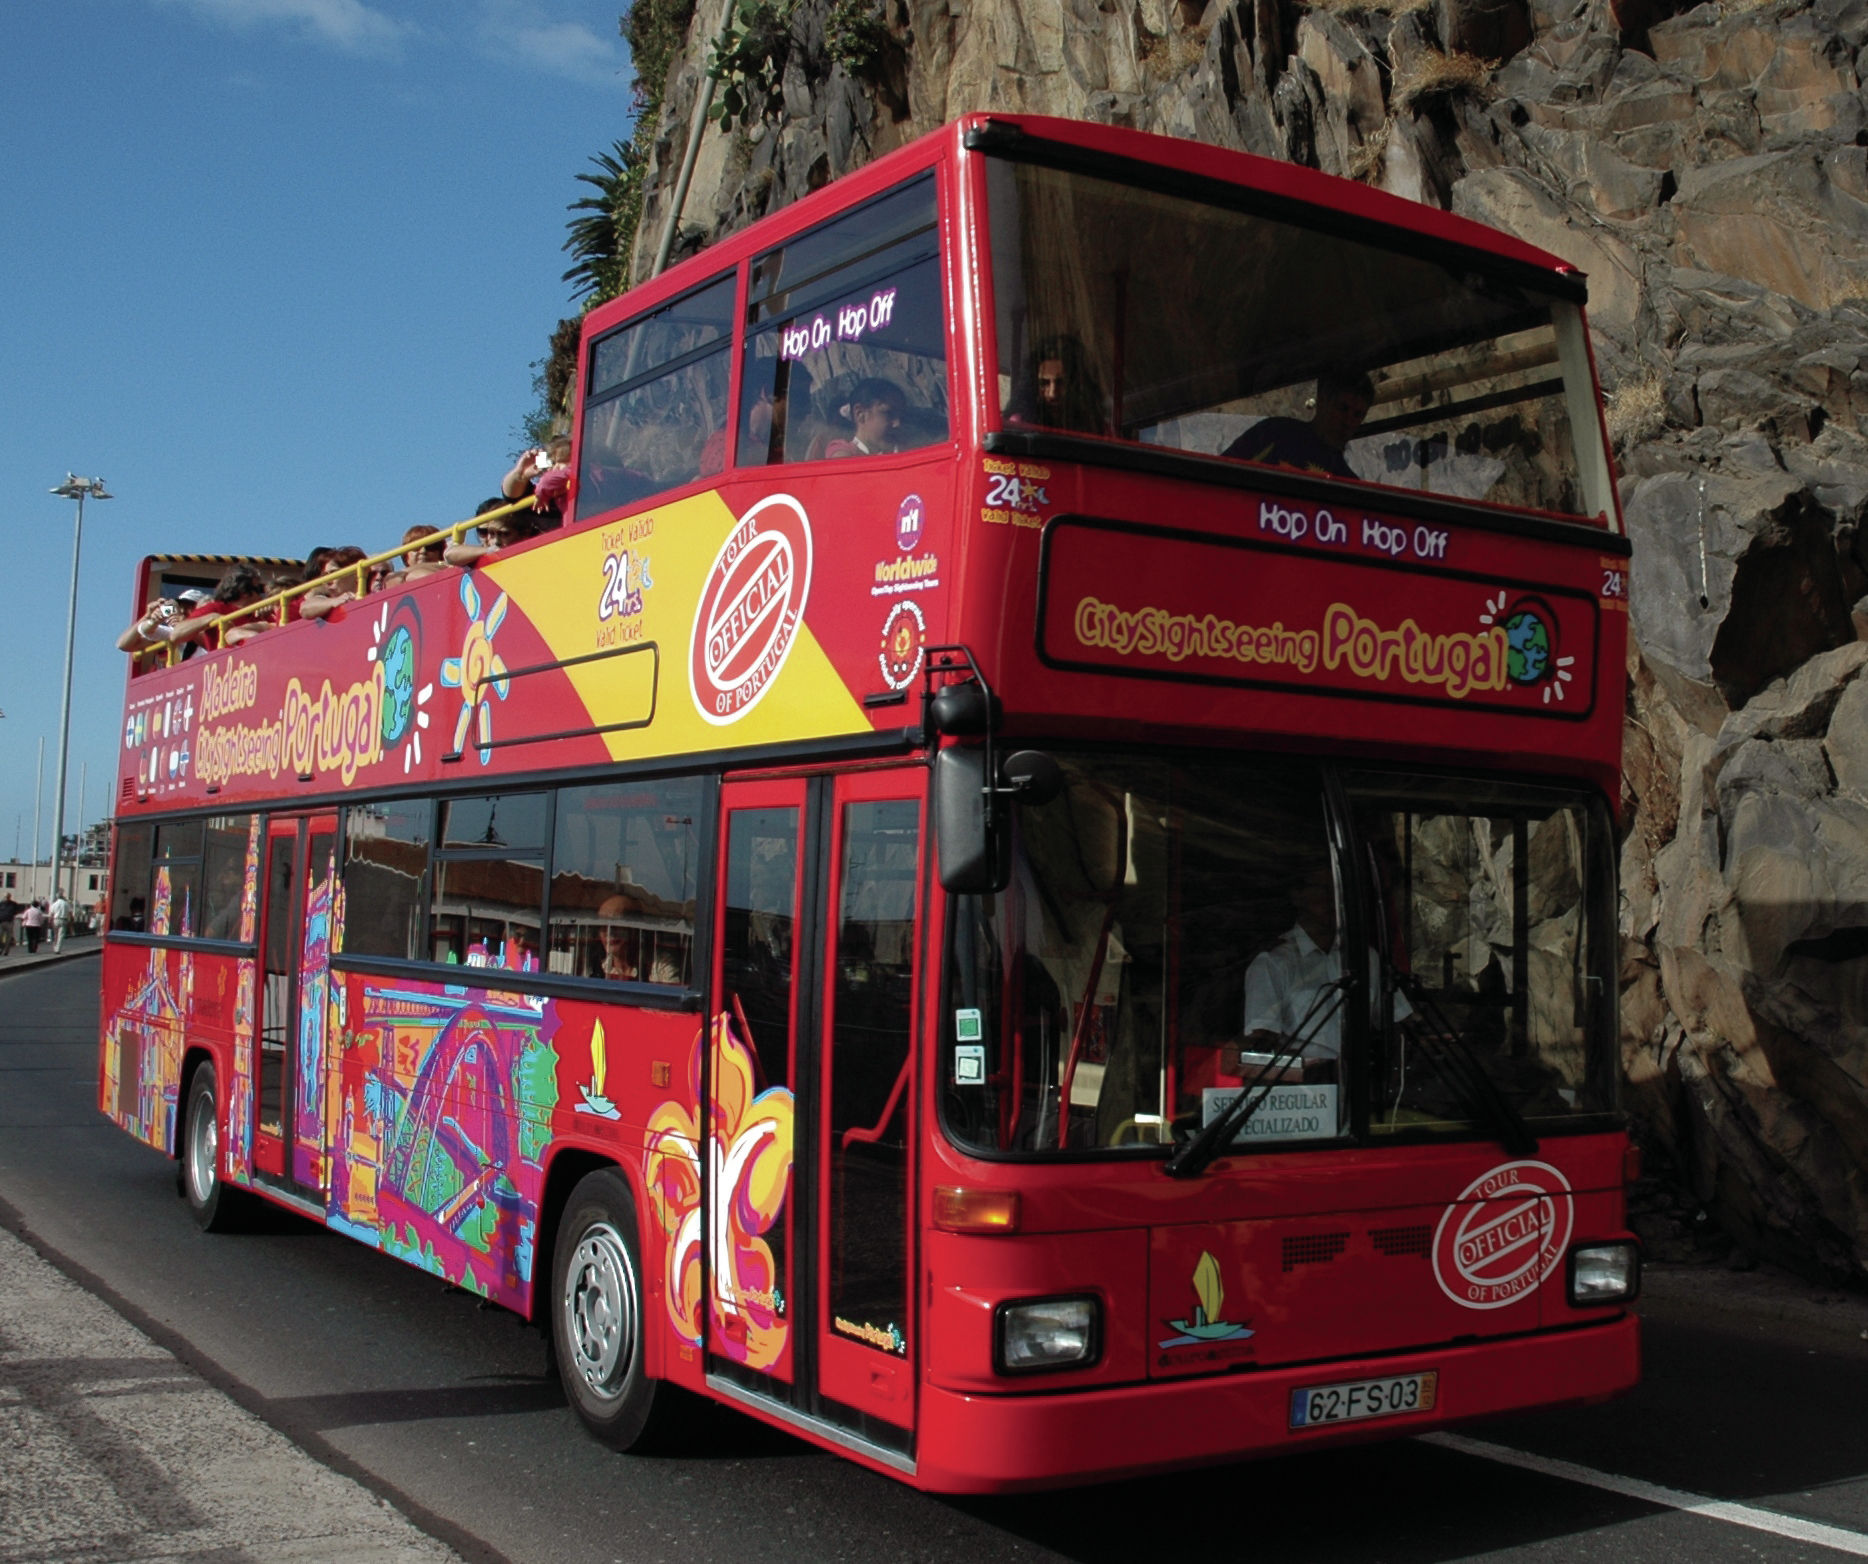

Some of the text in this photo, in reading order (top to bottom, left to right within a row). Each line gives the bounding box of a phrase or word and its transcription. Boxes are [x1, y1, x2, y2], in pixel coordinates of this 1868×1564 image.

[781, 290, 896, 359] Hop On Hop Off
[985, 475, 1020, 507] 24
[717, 517, 758, 576] TOUR
[1260, 502, 1448, 558] Hop On Hop Off
[599, 549, 629, 622] 24
[708, 552, 789, 668] OFFICIAL
[1602, 570, 1621, 597] 24
[716, 607, 800, 713] OF PORTUGAL
[1323, 602, 1509, 698] Portugal
[200, 655, 257, 723] Madeira
[281, 659, 385, 787] Portugal
[1234, 1116, 1320, 1136] ECIALIZADO
[1270, 1093, 1328, 1111] REGULAR
[1473, 1169, 1520, 1199] TOUR
[1460, 1204, 1550, 1265] OFFICIAL
[1467, 1244, 1560, 1301] OF PORTUGAL
